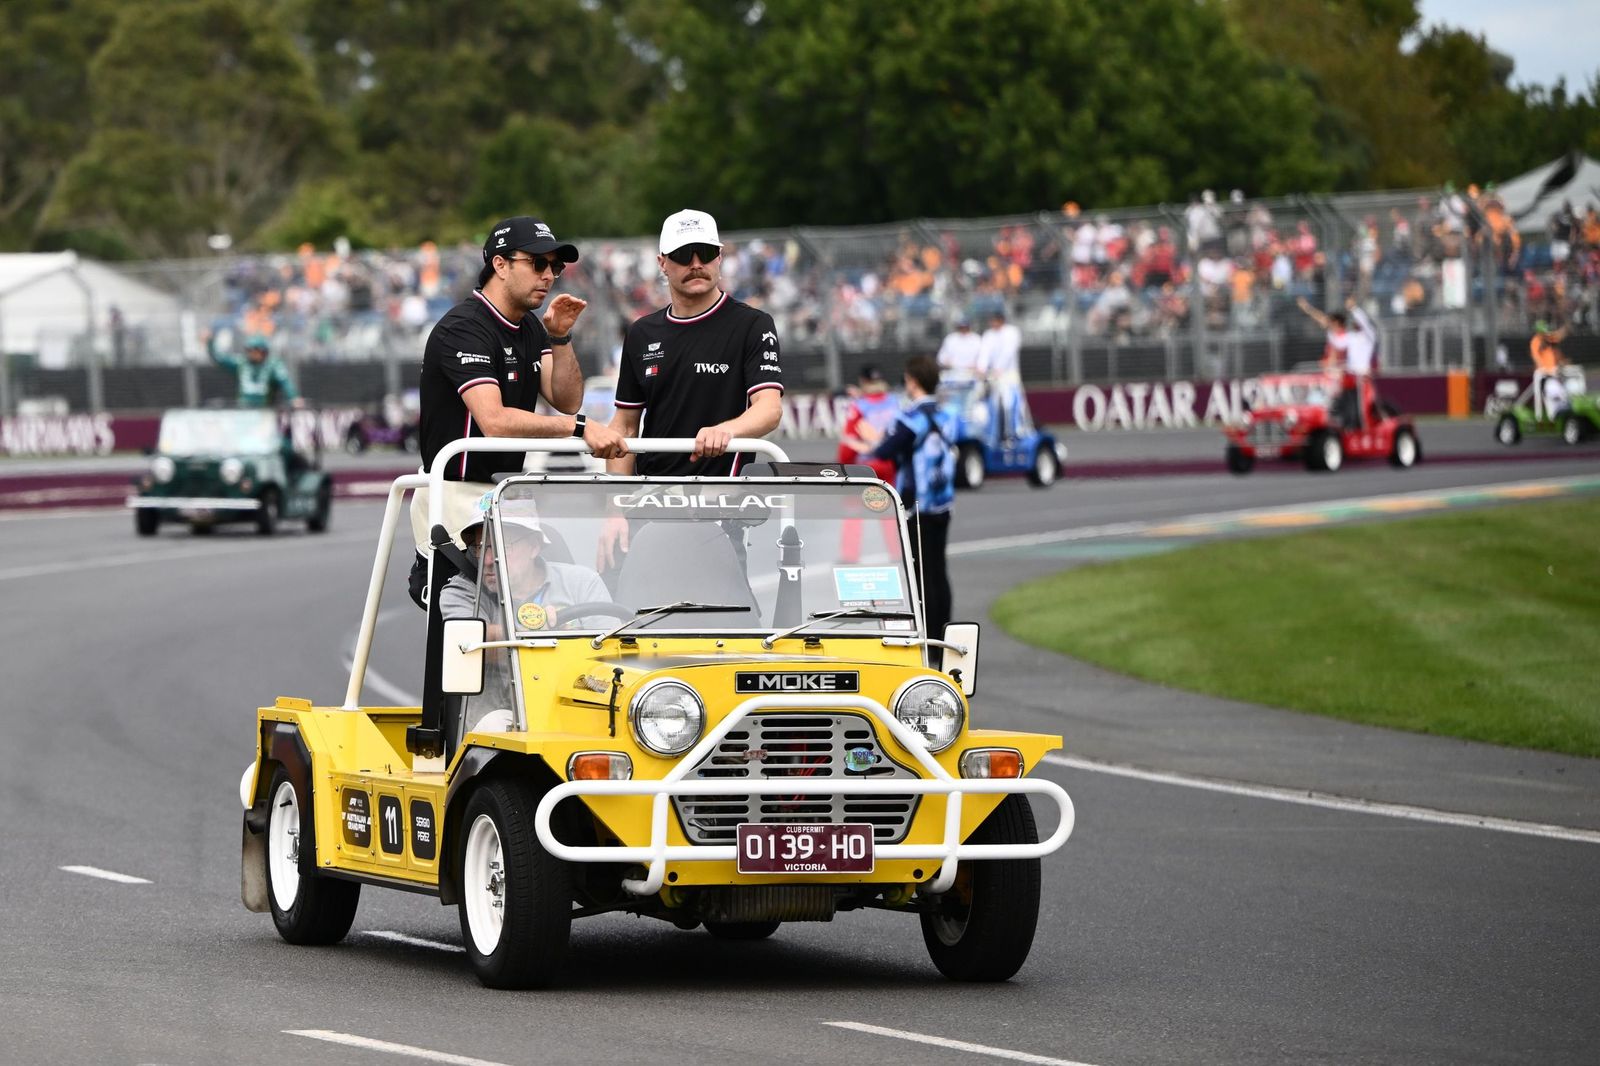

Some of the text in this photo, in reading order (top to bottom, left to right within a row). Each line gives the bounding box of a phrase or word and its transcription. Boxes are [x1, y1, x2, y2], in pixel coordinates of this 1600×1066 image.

[642, 350, 665, 358] CADILLAC
[694, 362, 720, 374] TWG
[1075, 381, 1199, 433] QATAR
[613, 494, 789, 509] CADILLAC
[758, 674, 837, 690] MOKE
[385, 805, 398, 845] 11
[415, 816, 431, 828] SERGIO
[417, 831, 431, 843] PEREZ
